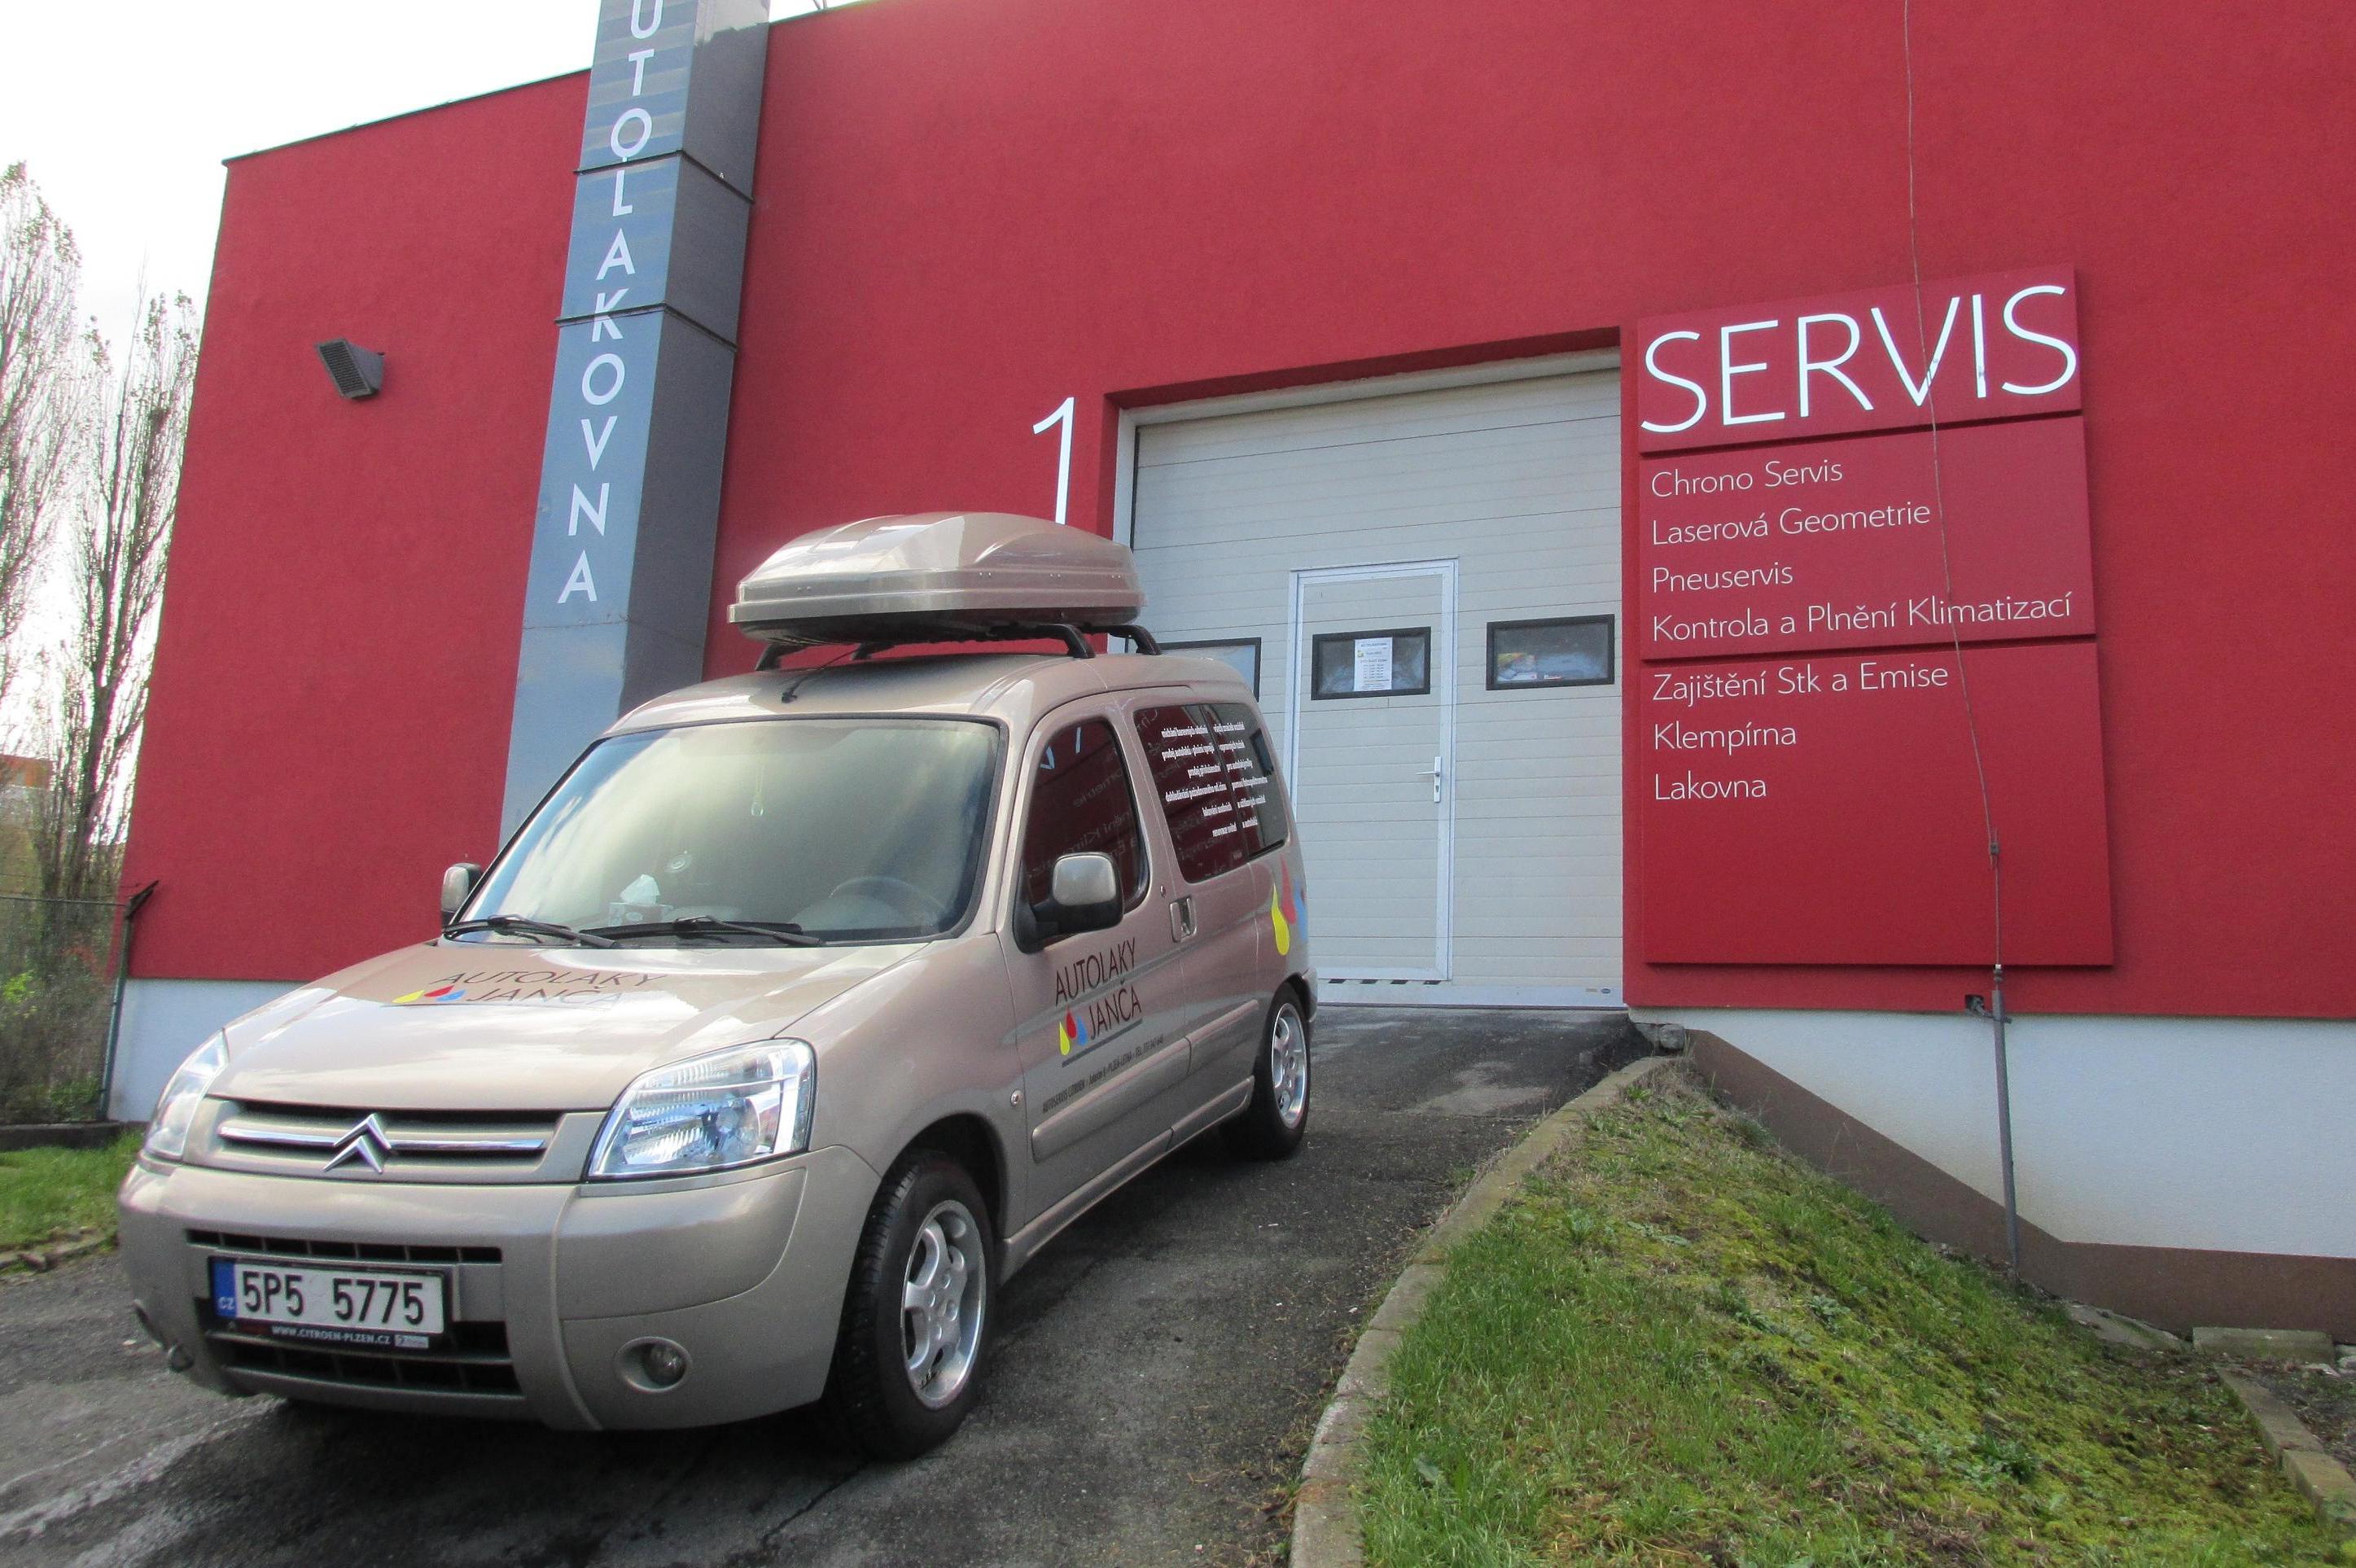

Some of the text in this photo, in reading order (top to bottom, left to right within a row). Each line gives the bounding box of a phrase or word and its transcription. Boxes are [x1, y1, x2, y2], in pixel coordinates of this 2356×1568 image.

[1640, 285, 2077, 433] SERVIS
[1032, 396, 1075, 525] 1
[1651, 459, 1843, 497] Chrono Servis
[1653, 501, 1931, 545] Laserová Geometrie
[1653, 562, 1793, 593] Pneuservis
[1653, 591, 2073, 642] Kontrola a Plnění Klimatizací
[1653, 662, 1948, 707] Zajištění Stk a Emise
[1654, 720, 1797, 756] Klempírna
[1655, 770, 1767, 800] Lakovna
[428, 970, 668, 987] AUTOLAKY
[1055, 937, 1136, 1007] AUTOLAKY
[218, 1269, 424, 1325] CZ 5P5 5775
